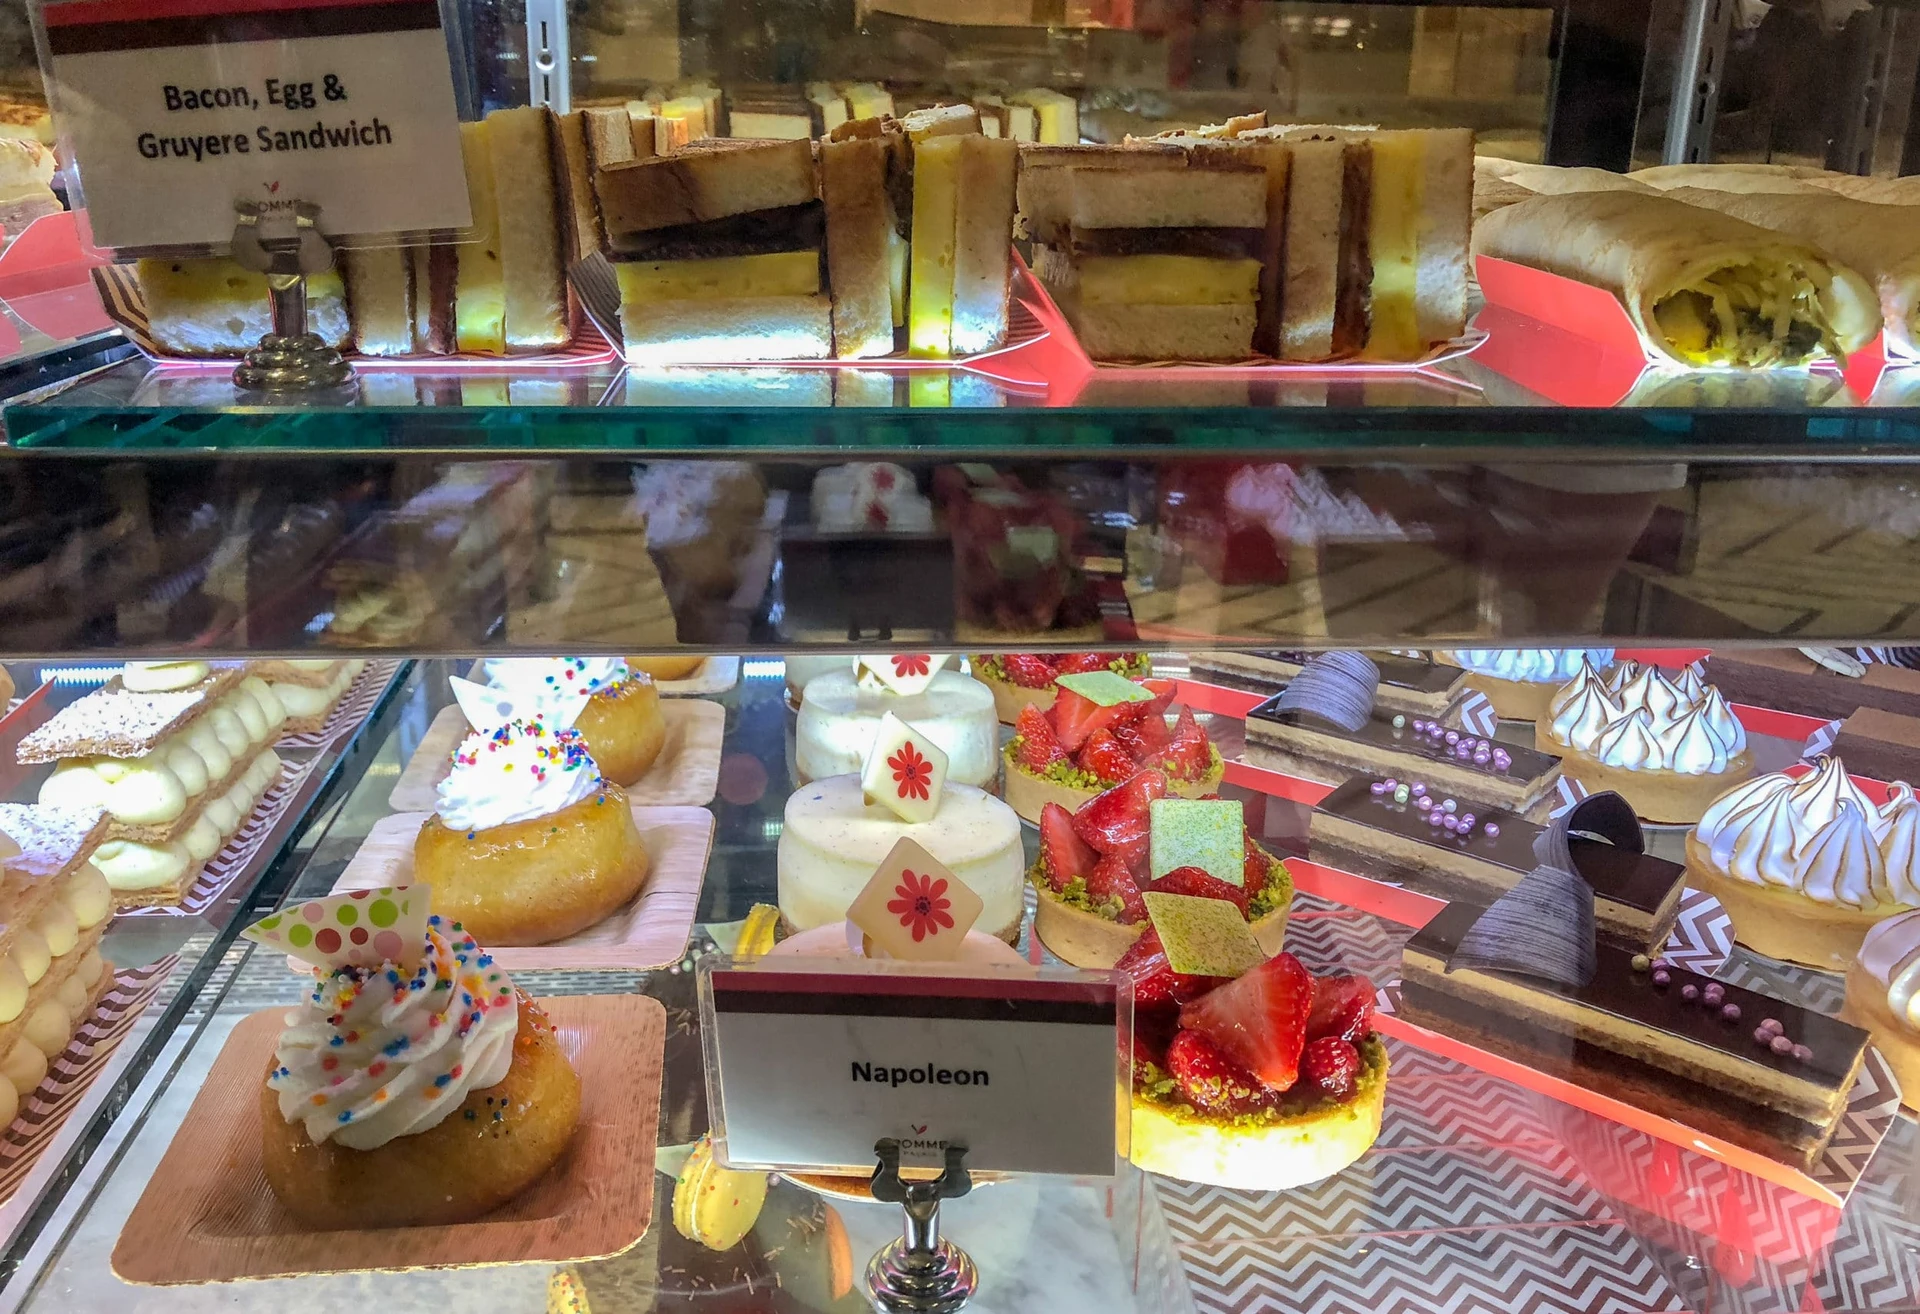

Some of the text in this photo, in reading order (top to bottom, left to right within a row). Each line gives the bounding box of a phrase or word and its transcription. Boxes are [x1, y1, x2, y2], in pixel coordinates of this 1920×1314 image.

[163, 73, 347, 111] Bacon, Egg &
[137, 117, 392, 162] Gruyere Sandwich
[851, 1061, 989, 1088] Napoleon
[895, 1139, 948, 1150] OMME
